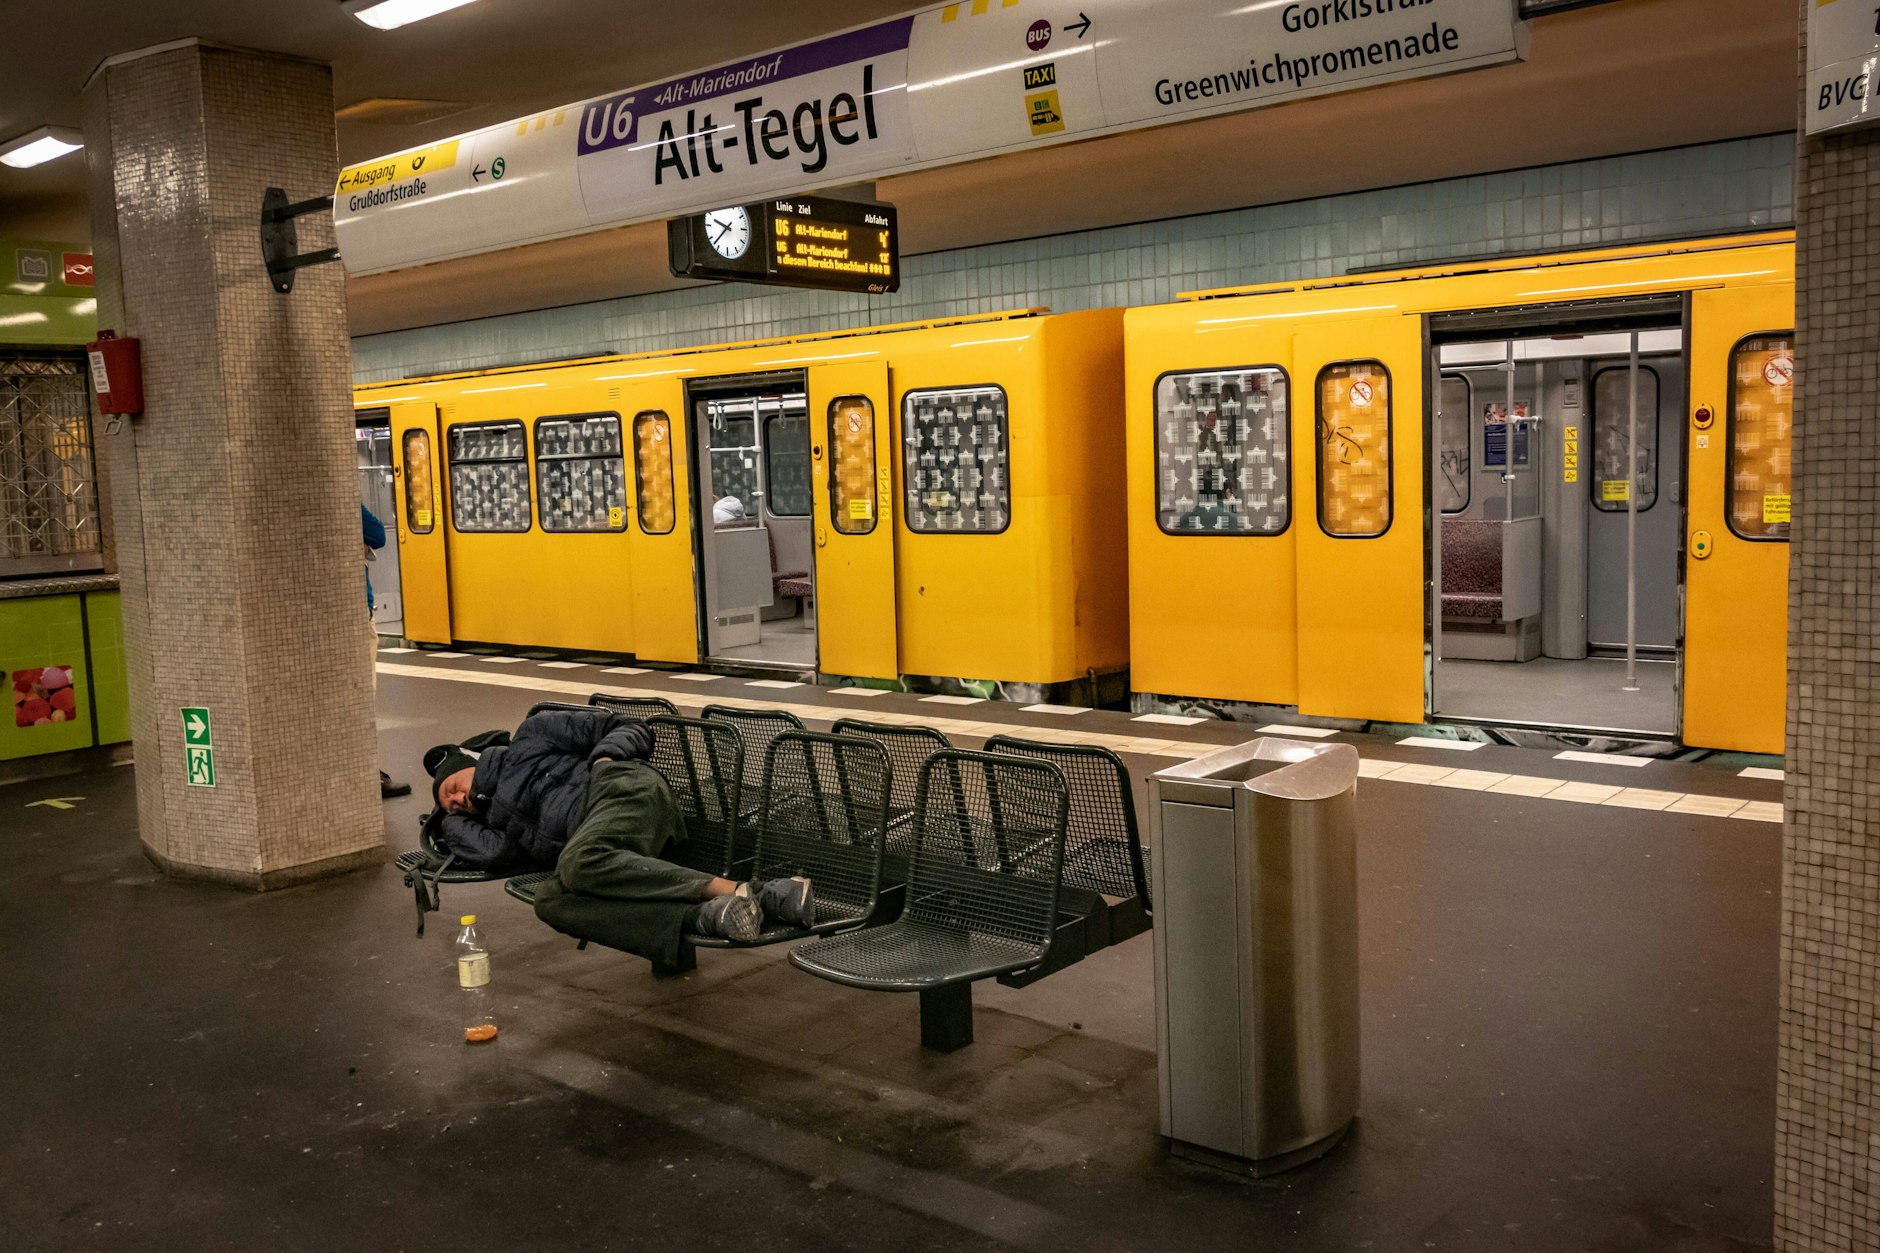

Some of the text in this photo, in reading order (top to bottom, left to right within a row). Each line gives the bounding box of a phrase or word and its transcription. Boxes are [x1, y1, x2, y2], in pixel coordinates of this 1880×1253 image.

[1028, 27, 1050, 43] BUS
[1025, 66, 1054, 85] TAXI
[1155, 22, 1459, 105] Greenwichpromenade
[661, 55, 783, 105] Alt-Mariendorf
[1818, 74, 1869, 110] BVG
[585, 96, 636, 146] U6
[655, 64, 879, 185] Alt-Tegel
[352, 164, 396, 186] Ausgang
[350, 178, 427, 211] Grußdorfstraße
[776, 201, 888, 226] Linie Ziel Abfahrt
[775, 219, 789, 236] U6
[795, 224, 848, 240] Alt-Mariendorf
[776, 241, 787, 252] U6
[796, 243, 848, 259] Alt-Mariendorf
